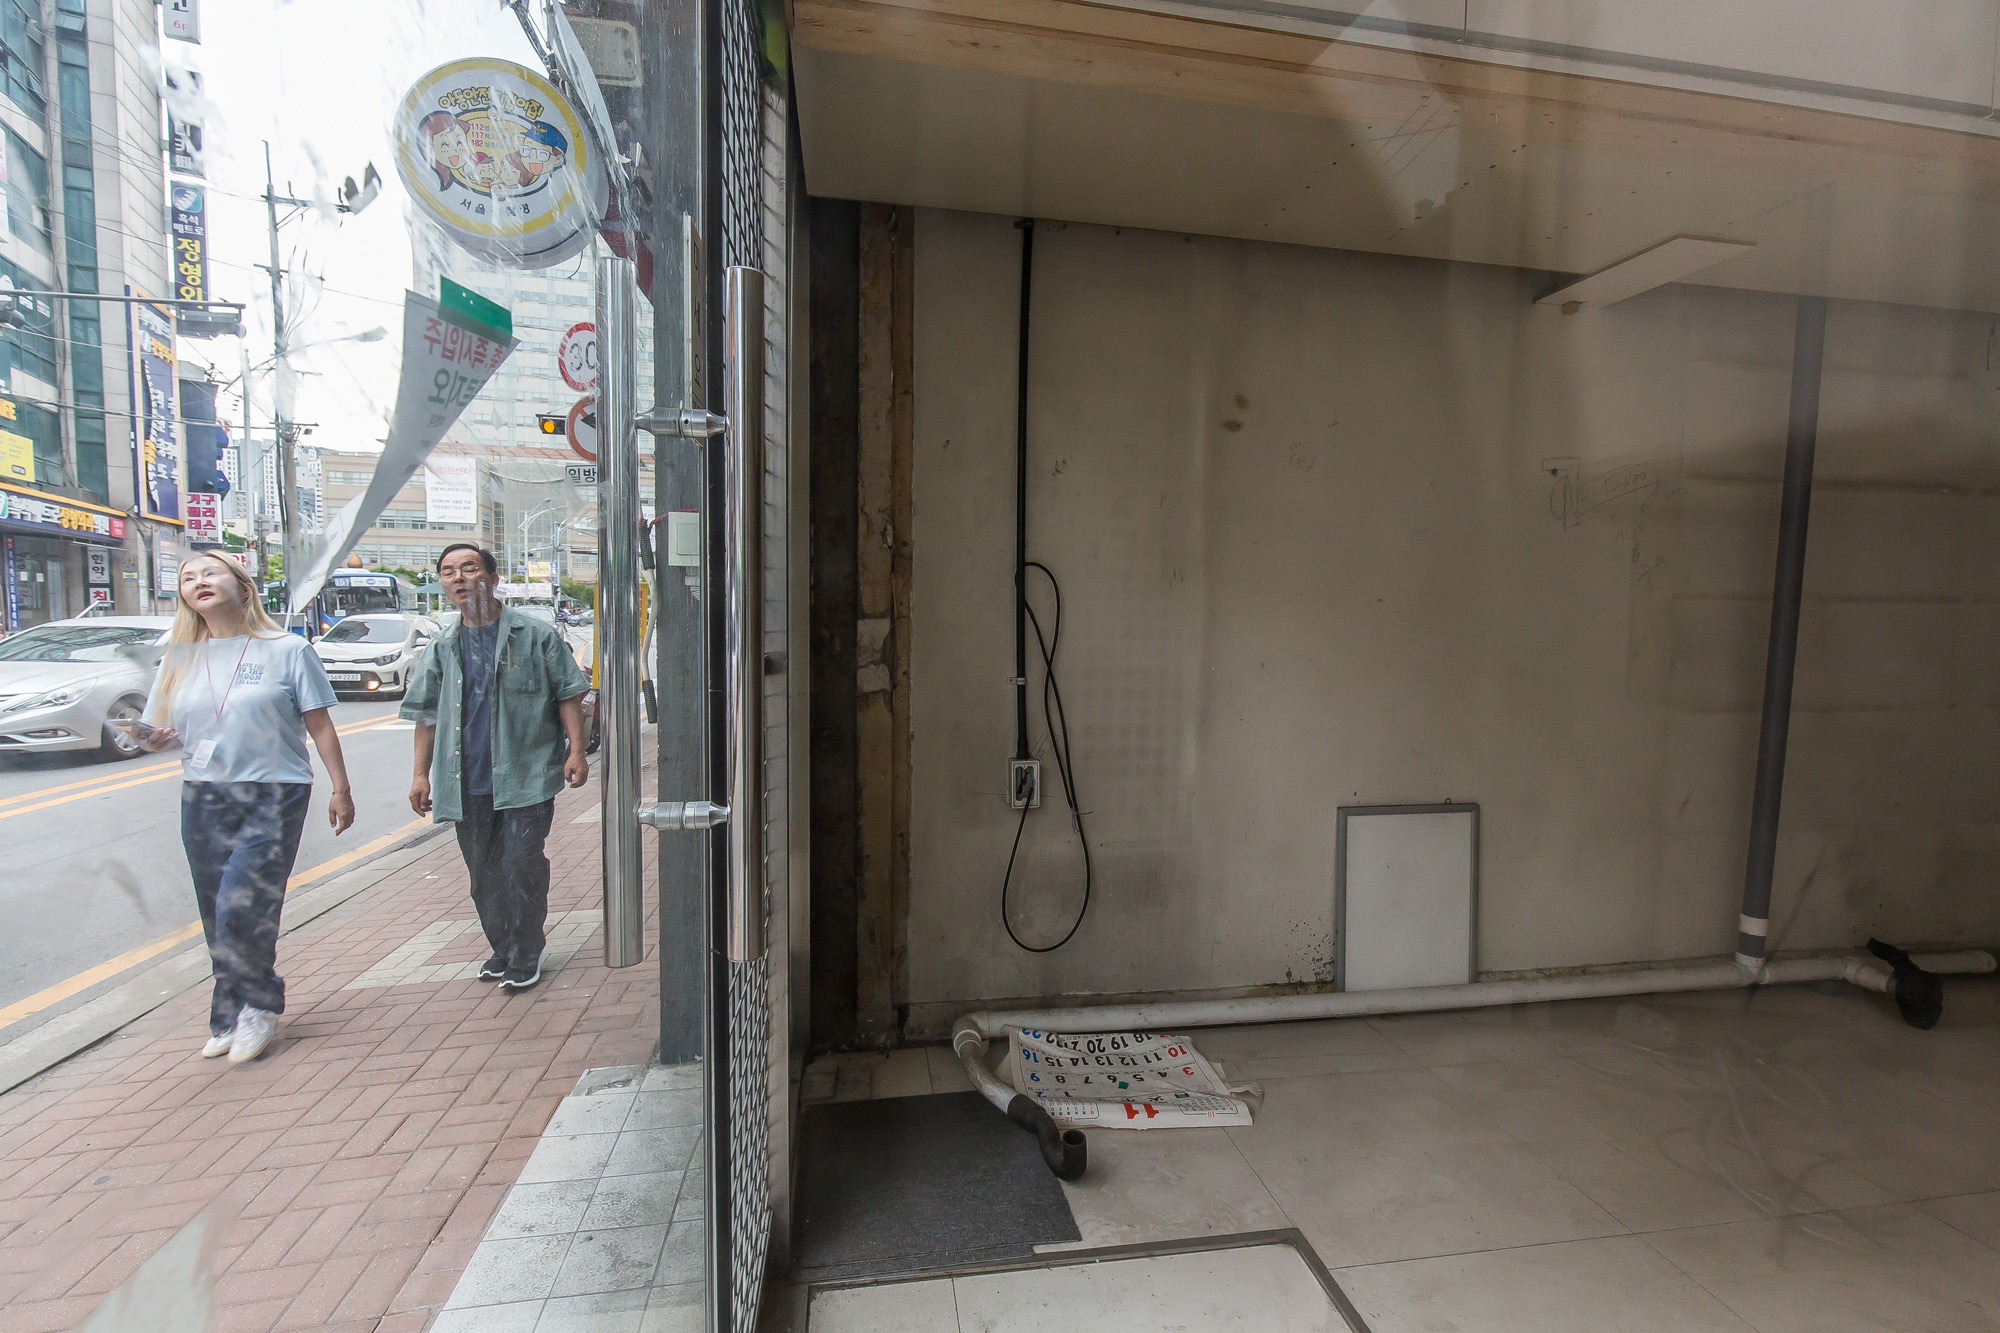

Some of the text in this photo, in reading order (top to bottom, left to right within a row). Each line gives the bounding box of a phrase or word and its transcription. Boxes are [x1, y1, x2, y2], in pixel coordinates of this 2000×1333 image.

[173, 20, 189, 31] 6F
[471, 123, 484, 131] 112
[471, 131, 484, 139] 117
[471, 140, 484, 148] 182
[173, 222, 204, 236] 메트로
[187, 519, 217, 531] 테스
[335, 579, 350, 587] 151
[1087, 1038, 1106, 1054] 20
[1111, 1035, 1129, 1050] 19
[1022, 1045, 1188, 1067] 10 11 12 13 14 15 16
[1182, 1066, 1195, 1075] 3
[1030, 1073, 1041, 1082] 9
[1055, 1075, 1067, 1084] 8
[1083, 1076, 1093, 1084] 7
[1106, 1074, 1117, 1084] 6
[1132, 1073, 1145, 1082] 5
[1123, 1103, 1160, 1120] 11
